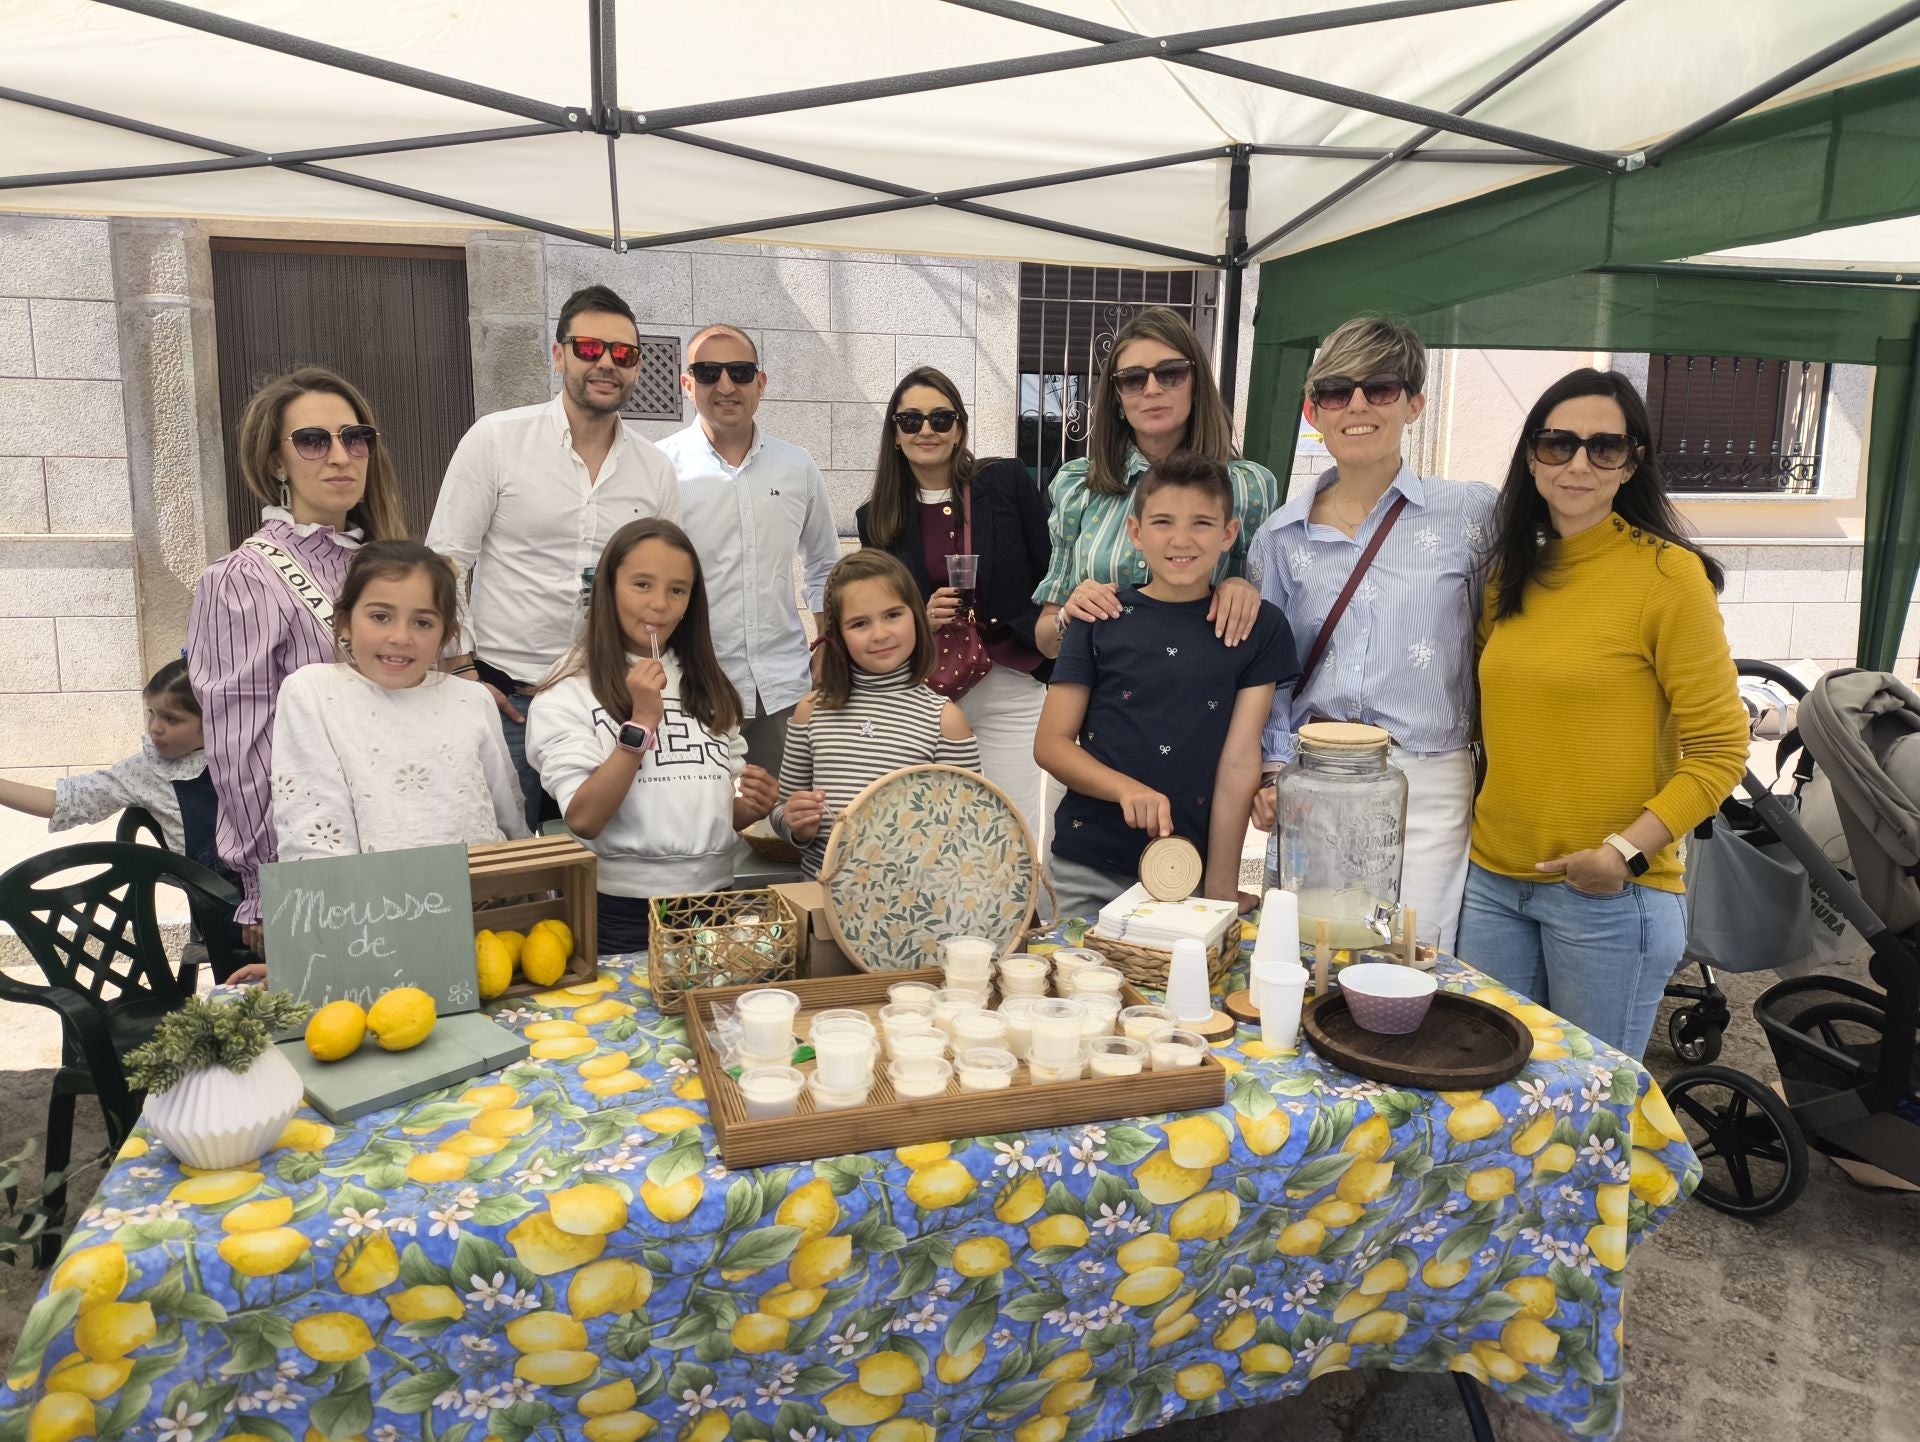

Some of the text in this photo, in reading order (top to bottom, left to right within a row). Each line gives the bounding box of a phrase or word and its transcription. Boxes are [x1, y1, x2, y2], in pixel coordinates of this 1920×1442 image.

[280, 563, 323, 609] LOLA
[637, 775, 672, 784] FLOWERS
[270, 887, 451, 937] Mousse
[347, 924, 397, 957] de
